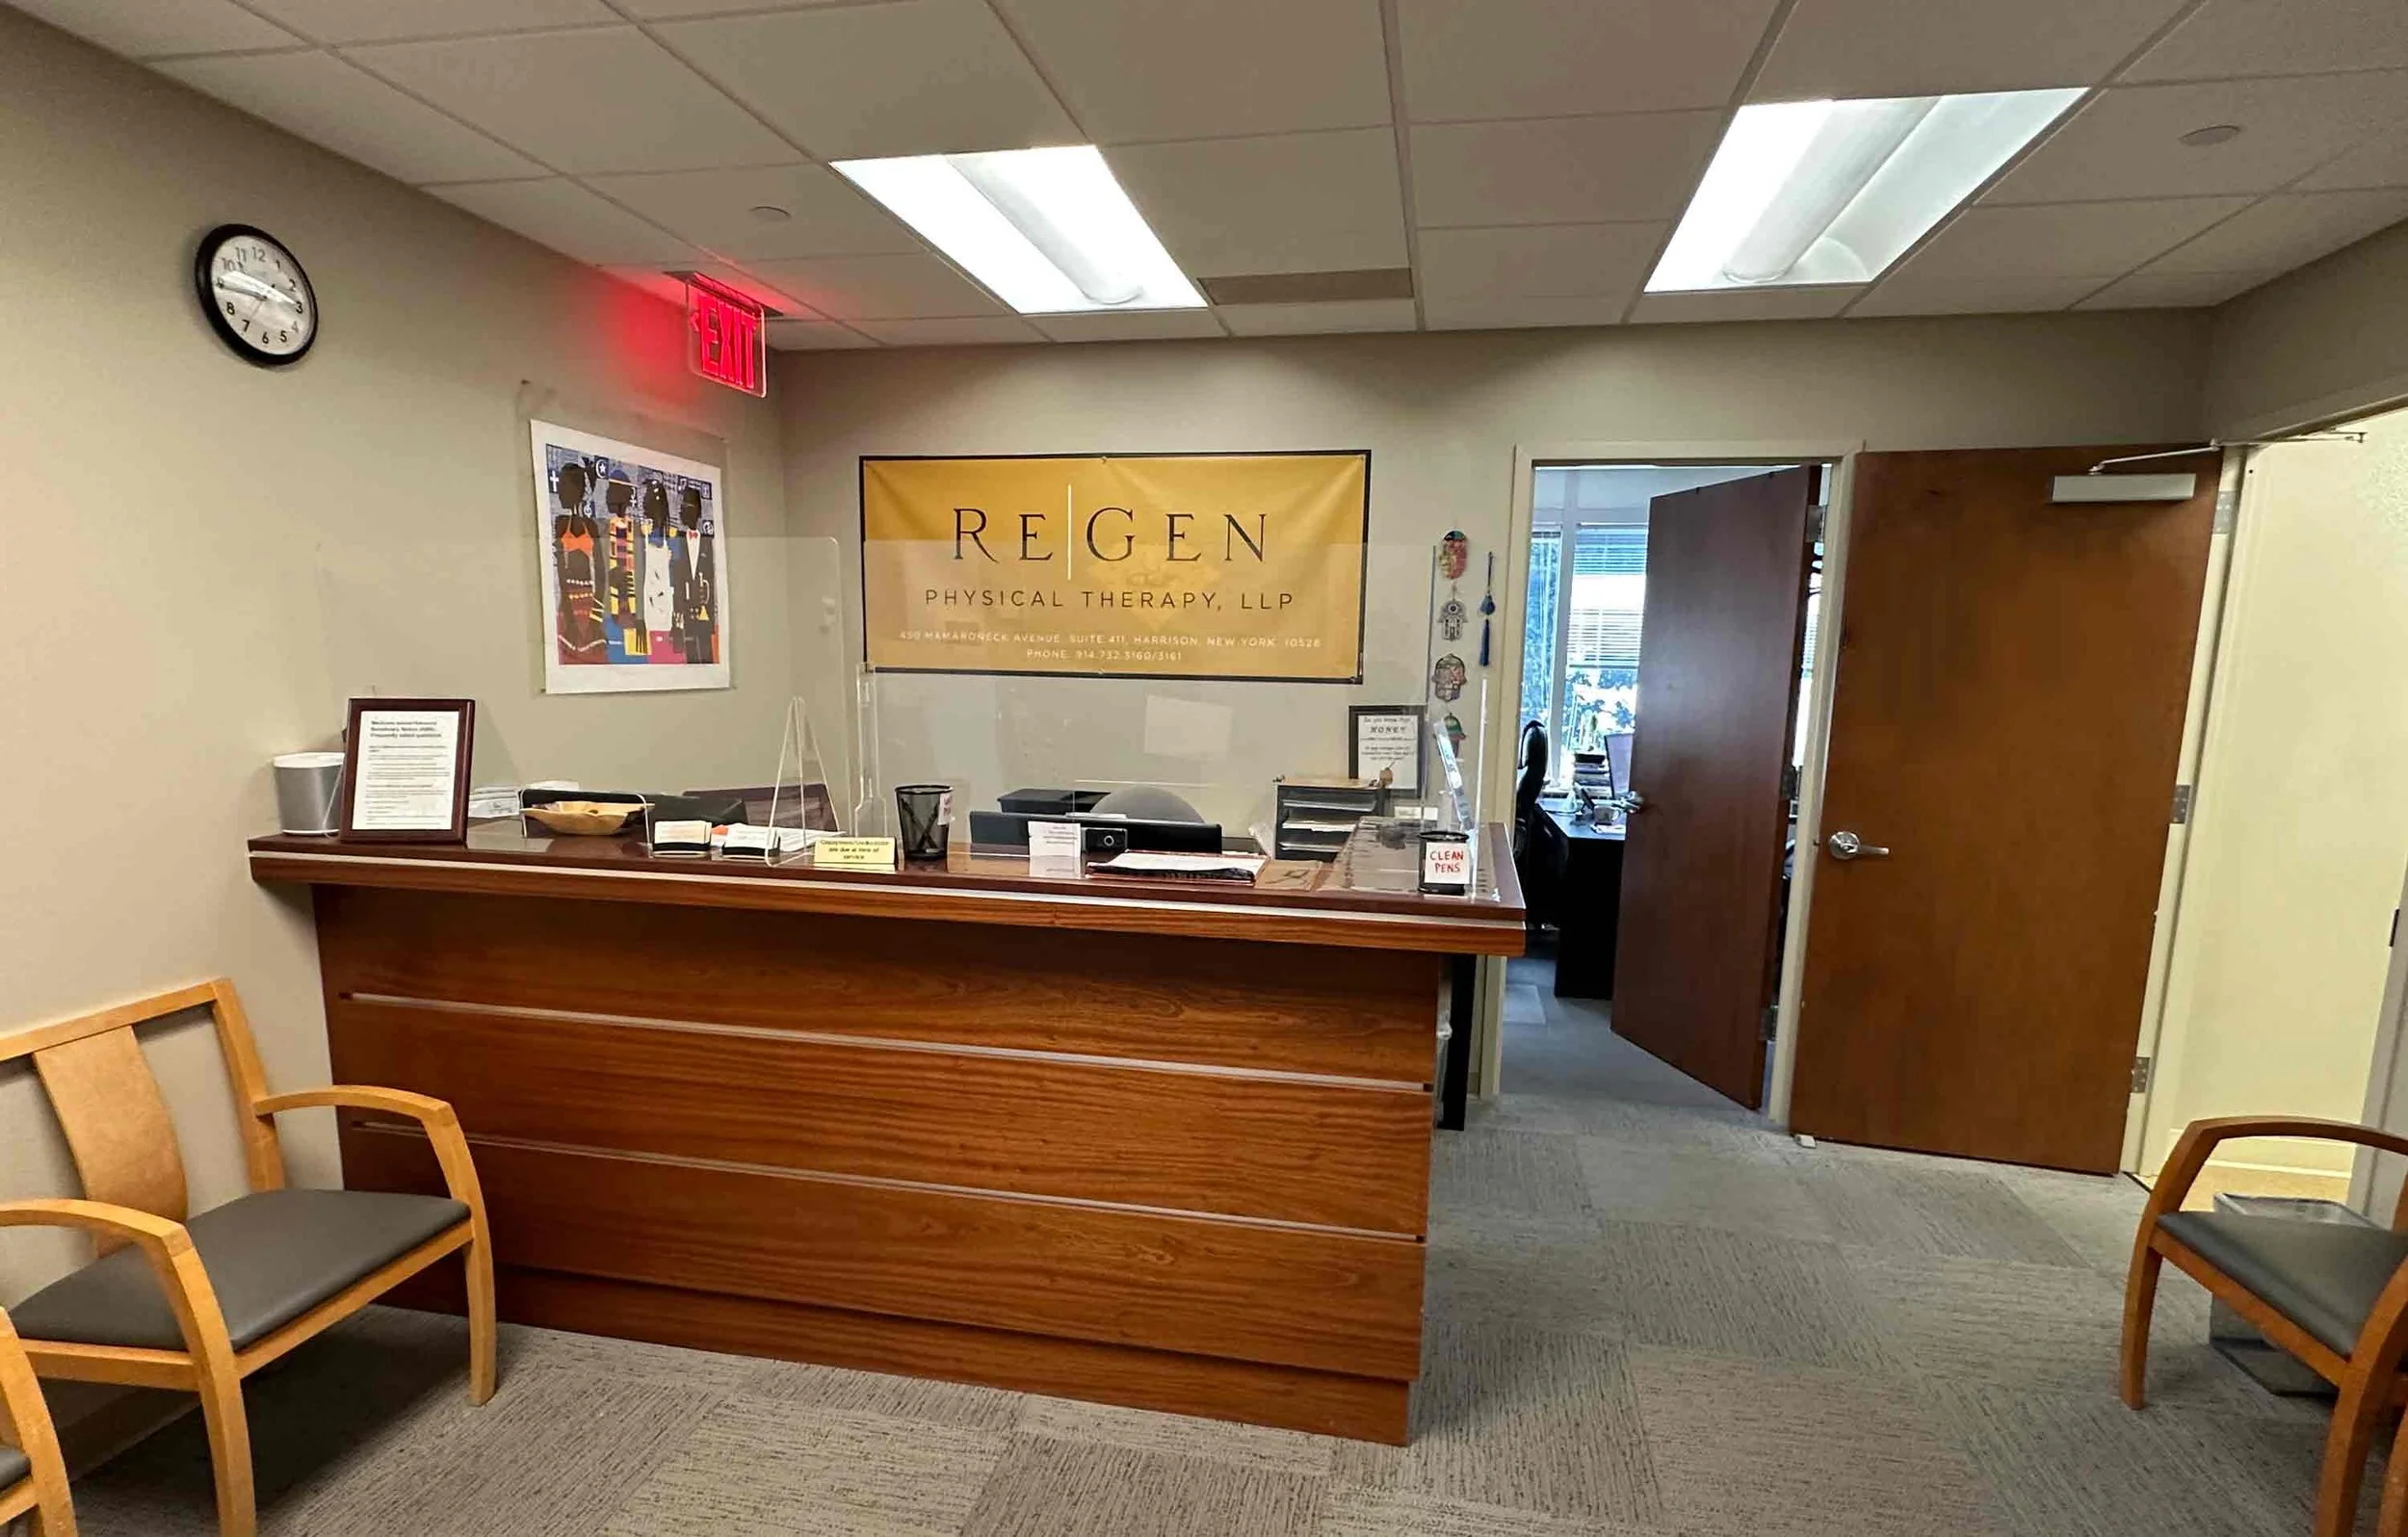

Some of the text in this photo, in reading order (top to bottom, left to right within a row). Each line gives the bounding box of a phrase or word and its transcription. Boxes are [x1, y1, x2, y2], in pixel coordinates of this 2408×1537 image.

[235, 246, 248, 263] 11
[251, 246, 266, 263] 12
[222, 257, 236, 272] 10
[275, 259, 281, 271] 1
[289, 278, 297, 293] 2
[225, 301, 236, 316] 8
[296, 300, 303, 315] 3
[242, 319, 250, 333] 7
[291, 320, 300, 334] 4
[261, 331, 270, 345] 6
[279, 330, 288, 344] 5
[700, 292, 757, 390] EXIT
[925, 588, 1294, 612] PHYSICAL THERAPY, LLP
[1069, 634, 1106, 645] SUITE
[1207, 636, 1235, 648] NEW
[1429, 850, 1464, 861] CLEAN
[1434, 862, 1460, 873] PENS
